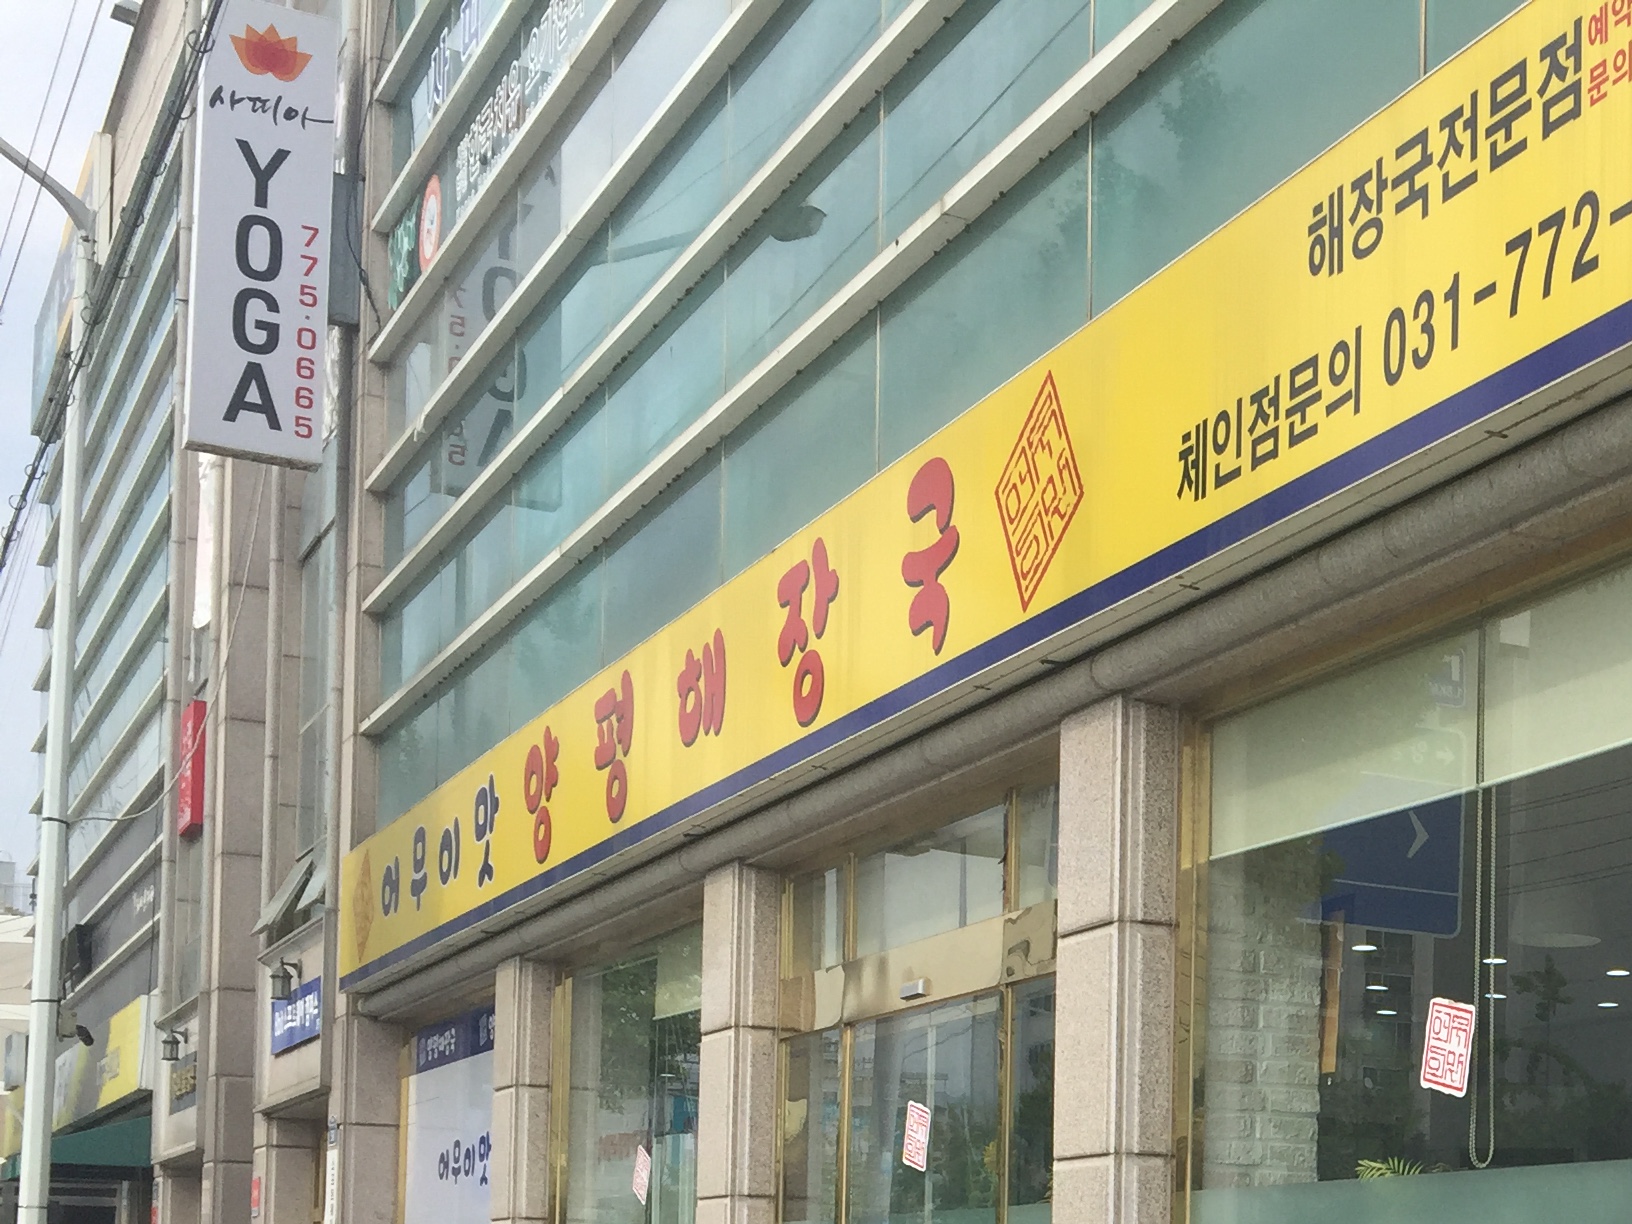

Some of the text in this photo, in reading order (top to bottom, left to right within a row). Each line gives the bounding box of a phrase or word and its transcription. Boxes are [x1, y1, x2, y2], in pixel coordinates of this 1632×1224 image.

[1307, 15, 1583, 279] 해장국전문점
[1588, 39, 1632, 107] 문의
[222, 138, 292, 431] YOGA
[1176, 324, 1363, 503] 체인점문의
[382, 774, 500, 917] 어무이맛
[524, 456, 959, 864] 양평해장국
